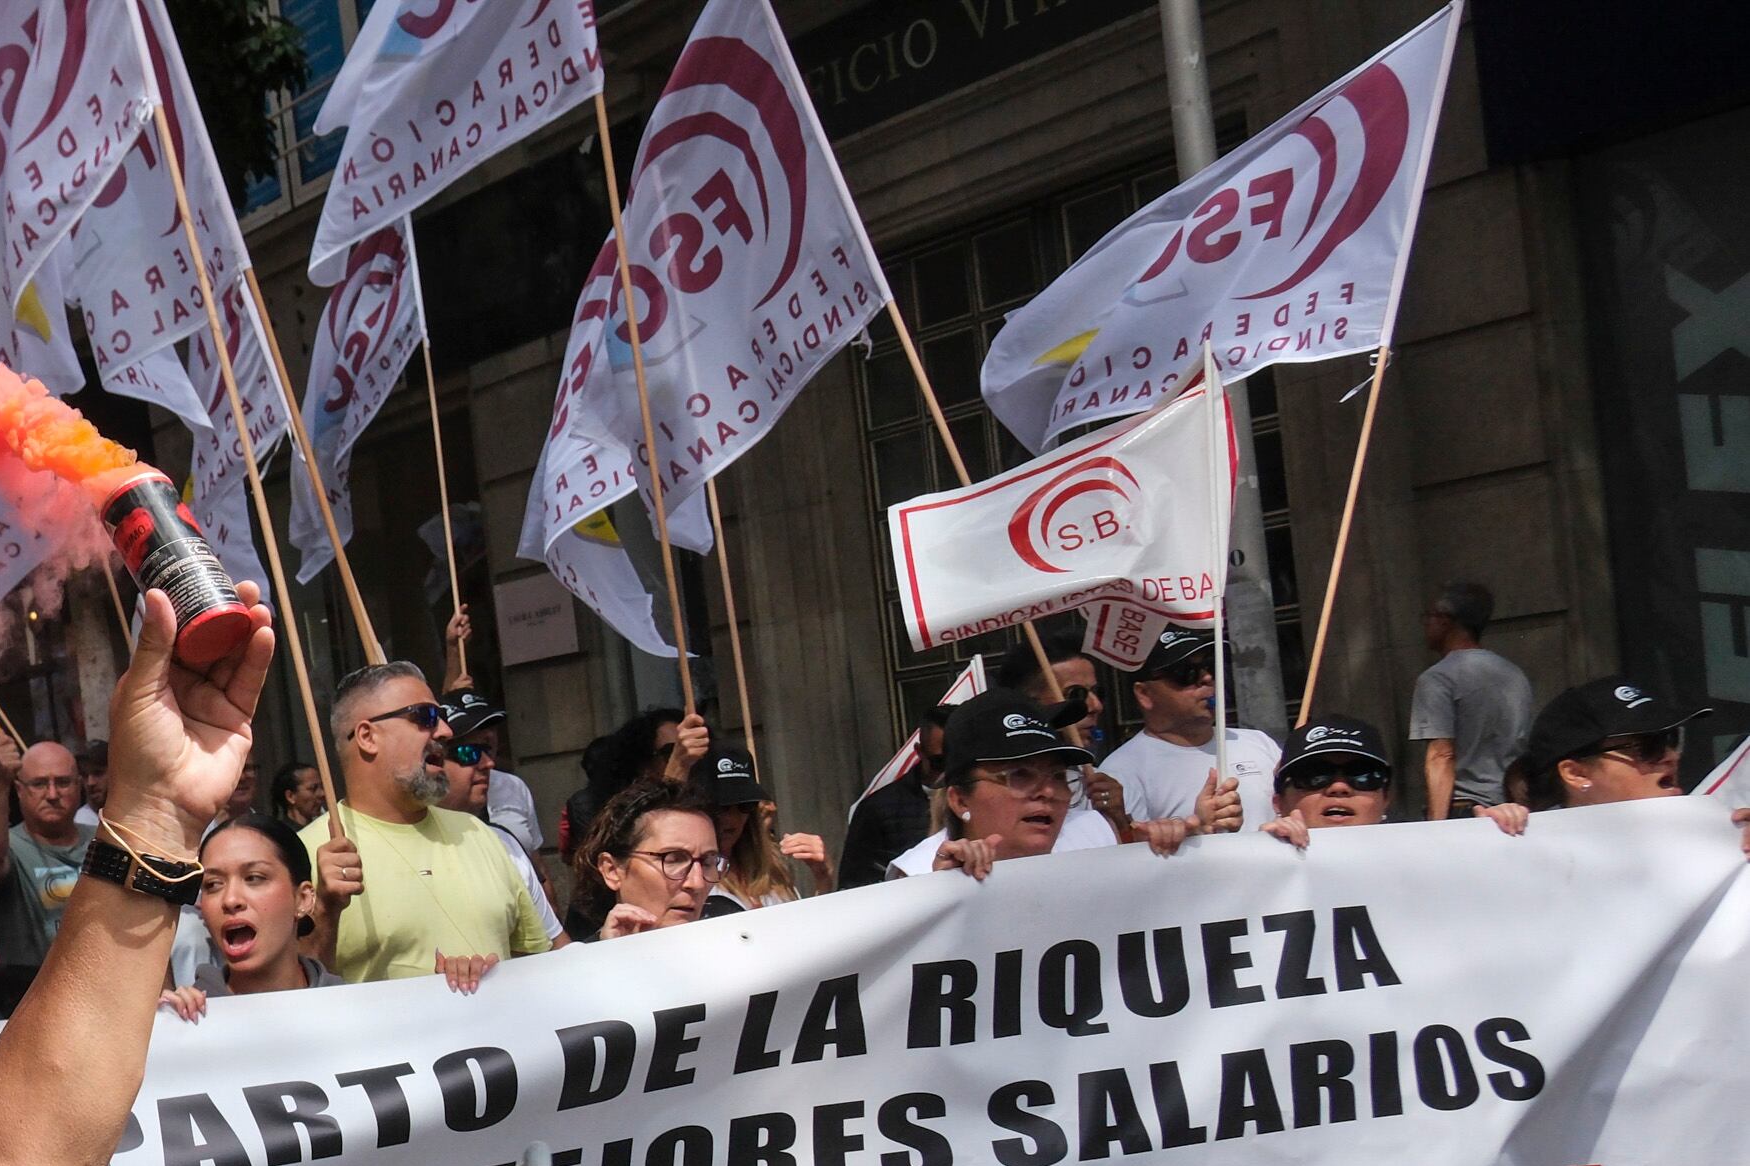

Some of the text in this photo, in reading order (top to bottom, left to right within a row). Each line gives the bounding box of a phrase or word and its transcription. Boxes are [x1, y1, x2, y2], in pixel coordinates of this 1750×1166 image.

[1058, 510, 1131, 551] S.B.
[1142, 577, 1174, 602] DE
[1112, 606, 1147, 656] BASE
[555, 1004, 706, 1112] DE
[733, 973, 868, 1075] LA
[906, 905, 1402, 1050] RIQUEZA
